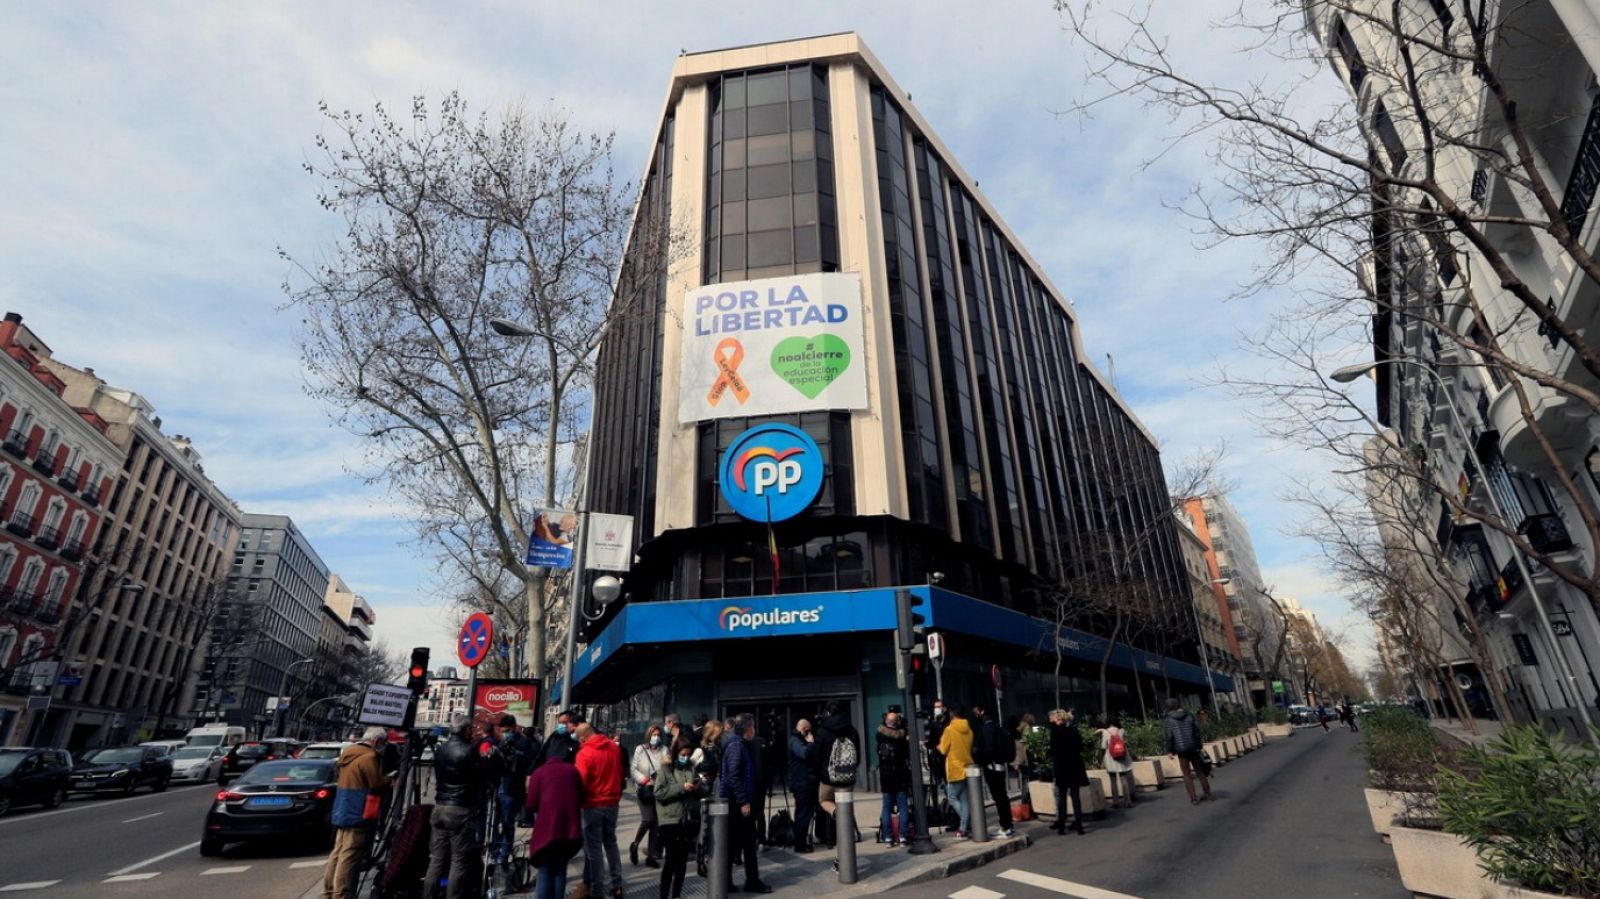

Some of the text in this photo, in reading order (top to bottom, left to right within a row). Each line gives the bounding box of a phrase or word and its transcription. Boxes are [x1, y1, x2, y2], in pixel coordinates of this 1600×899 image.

[696, 285, 808, 315] POR LA
[695, 304, 848, 336] LIBERTAD
[778, 351, 843, 363] noalcierre
[783, 366, 838, 377] educación
[788, 373, 834, 385] especial
[729, 608, 820, 631] populares
[488, 690, 520, 702] nocilla
